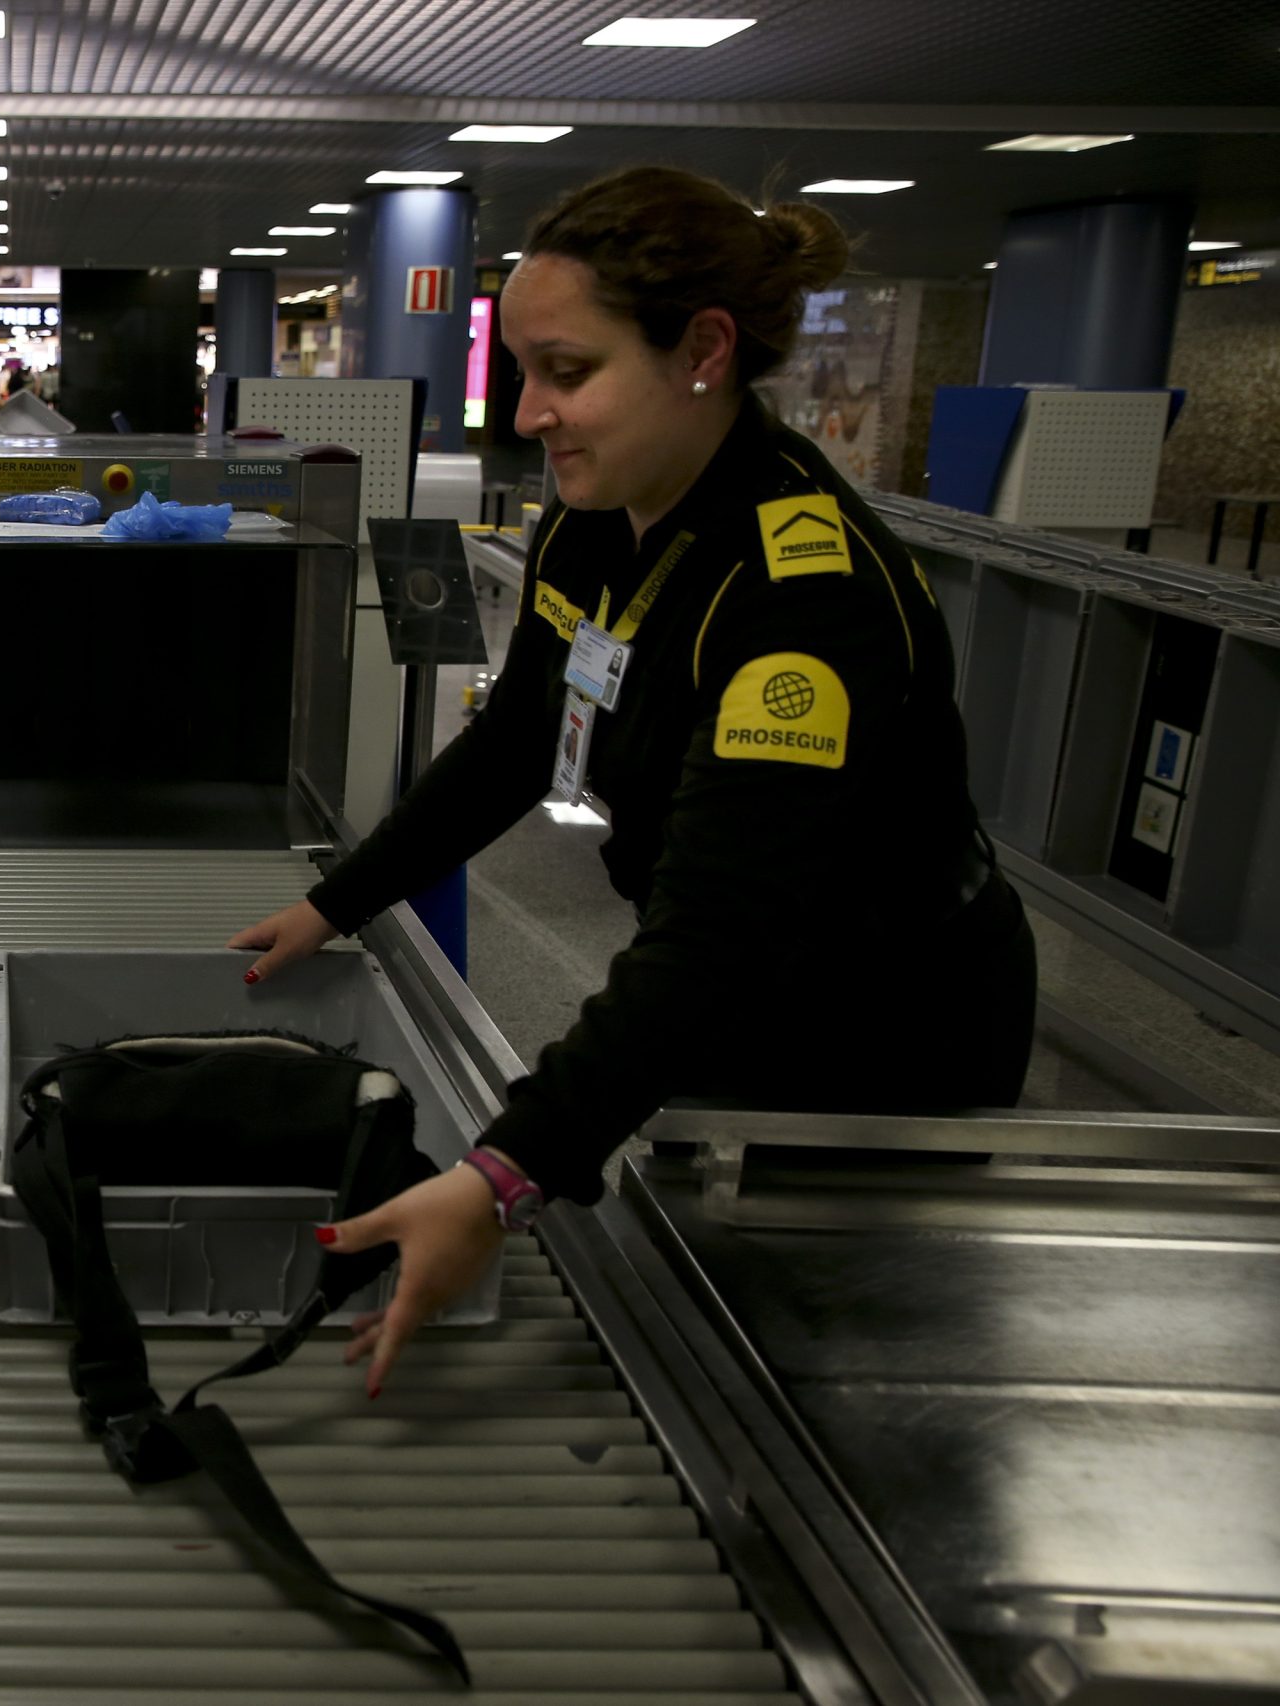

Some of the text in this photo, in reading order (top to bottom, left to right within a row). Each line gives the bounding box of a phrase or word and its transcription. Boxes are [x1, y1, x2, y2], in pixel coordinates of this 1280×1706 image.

[19, 463, 77, 472] RADIATION
[227, 464, 283, 475] SIEMENS
[218, 481, 294, 497] smiths
[780, 540, 838, 556] PROSEGUR
[642, 538, 691, 605] PROSEGUR
[725, 728, 838, 754] PROSEGUR
